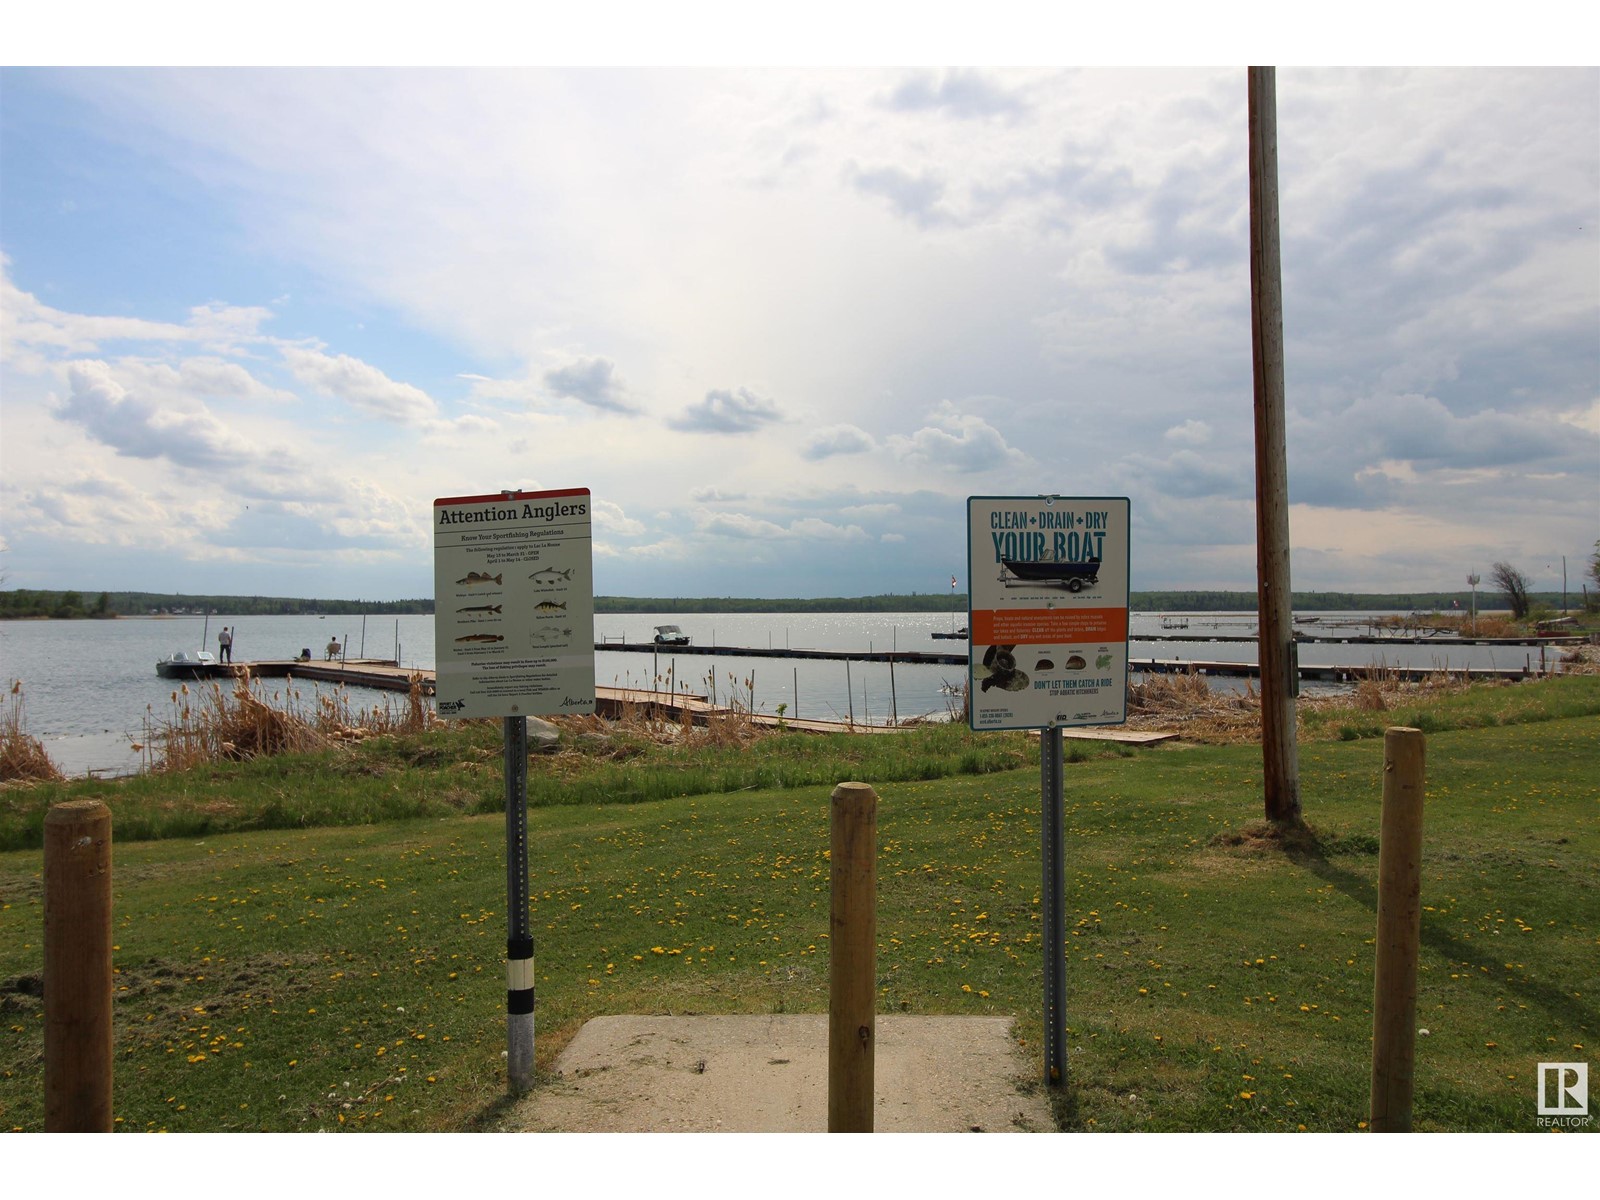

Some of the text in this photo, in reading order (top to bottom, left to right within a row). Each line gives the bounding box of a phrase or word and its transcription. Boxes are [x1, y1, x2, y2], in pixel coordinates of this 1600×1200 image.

[440, 502, 586, 524] Attention Anglers
[991, 512, 1027, 529] CLEAN
[1039, 512, 1074, 529] DRAIN
[1086, 512, 1108, 529] DRY
[493, 532, 529, 540] Sportfishing
[530, 530, 564, 538] Regulations
[992, 532, 1106, 563] YOUR BOAT
[1034, 678, 1112, 689] DON'T LET THEM CATCH A RIDE
[559, 696, 587, 707] Alberta
